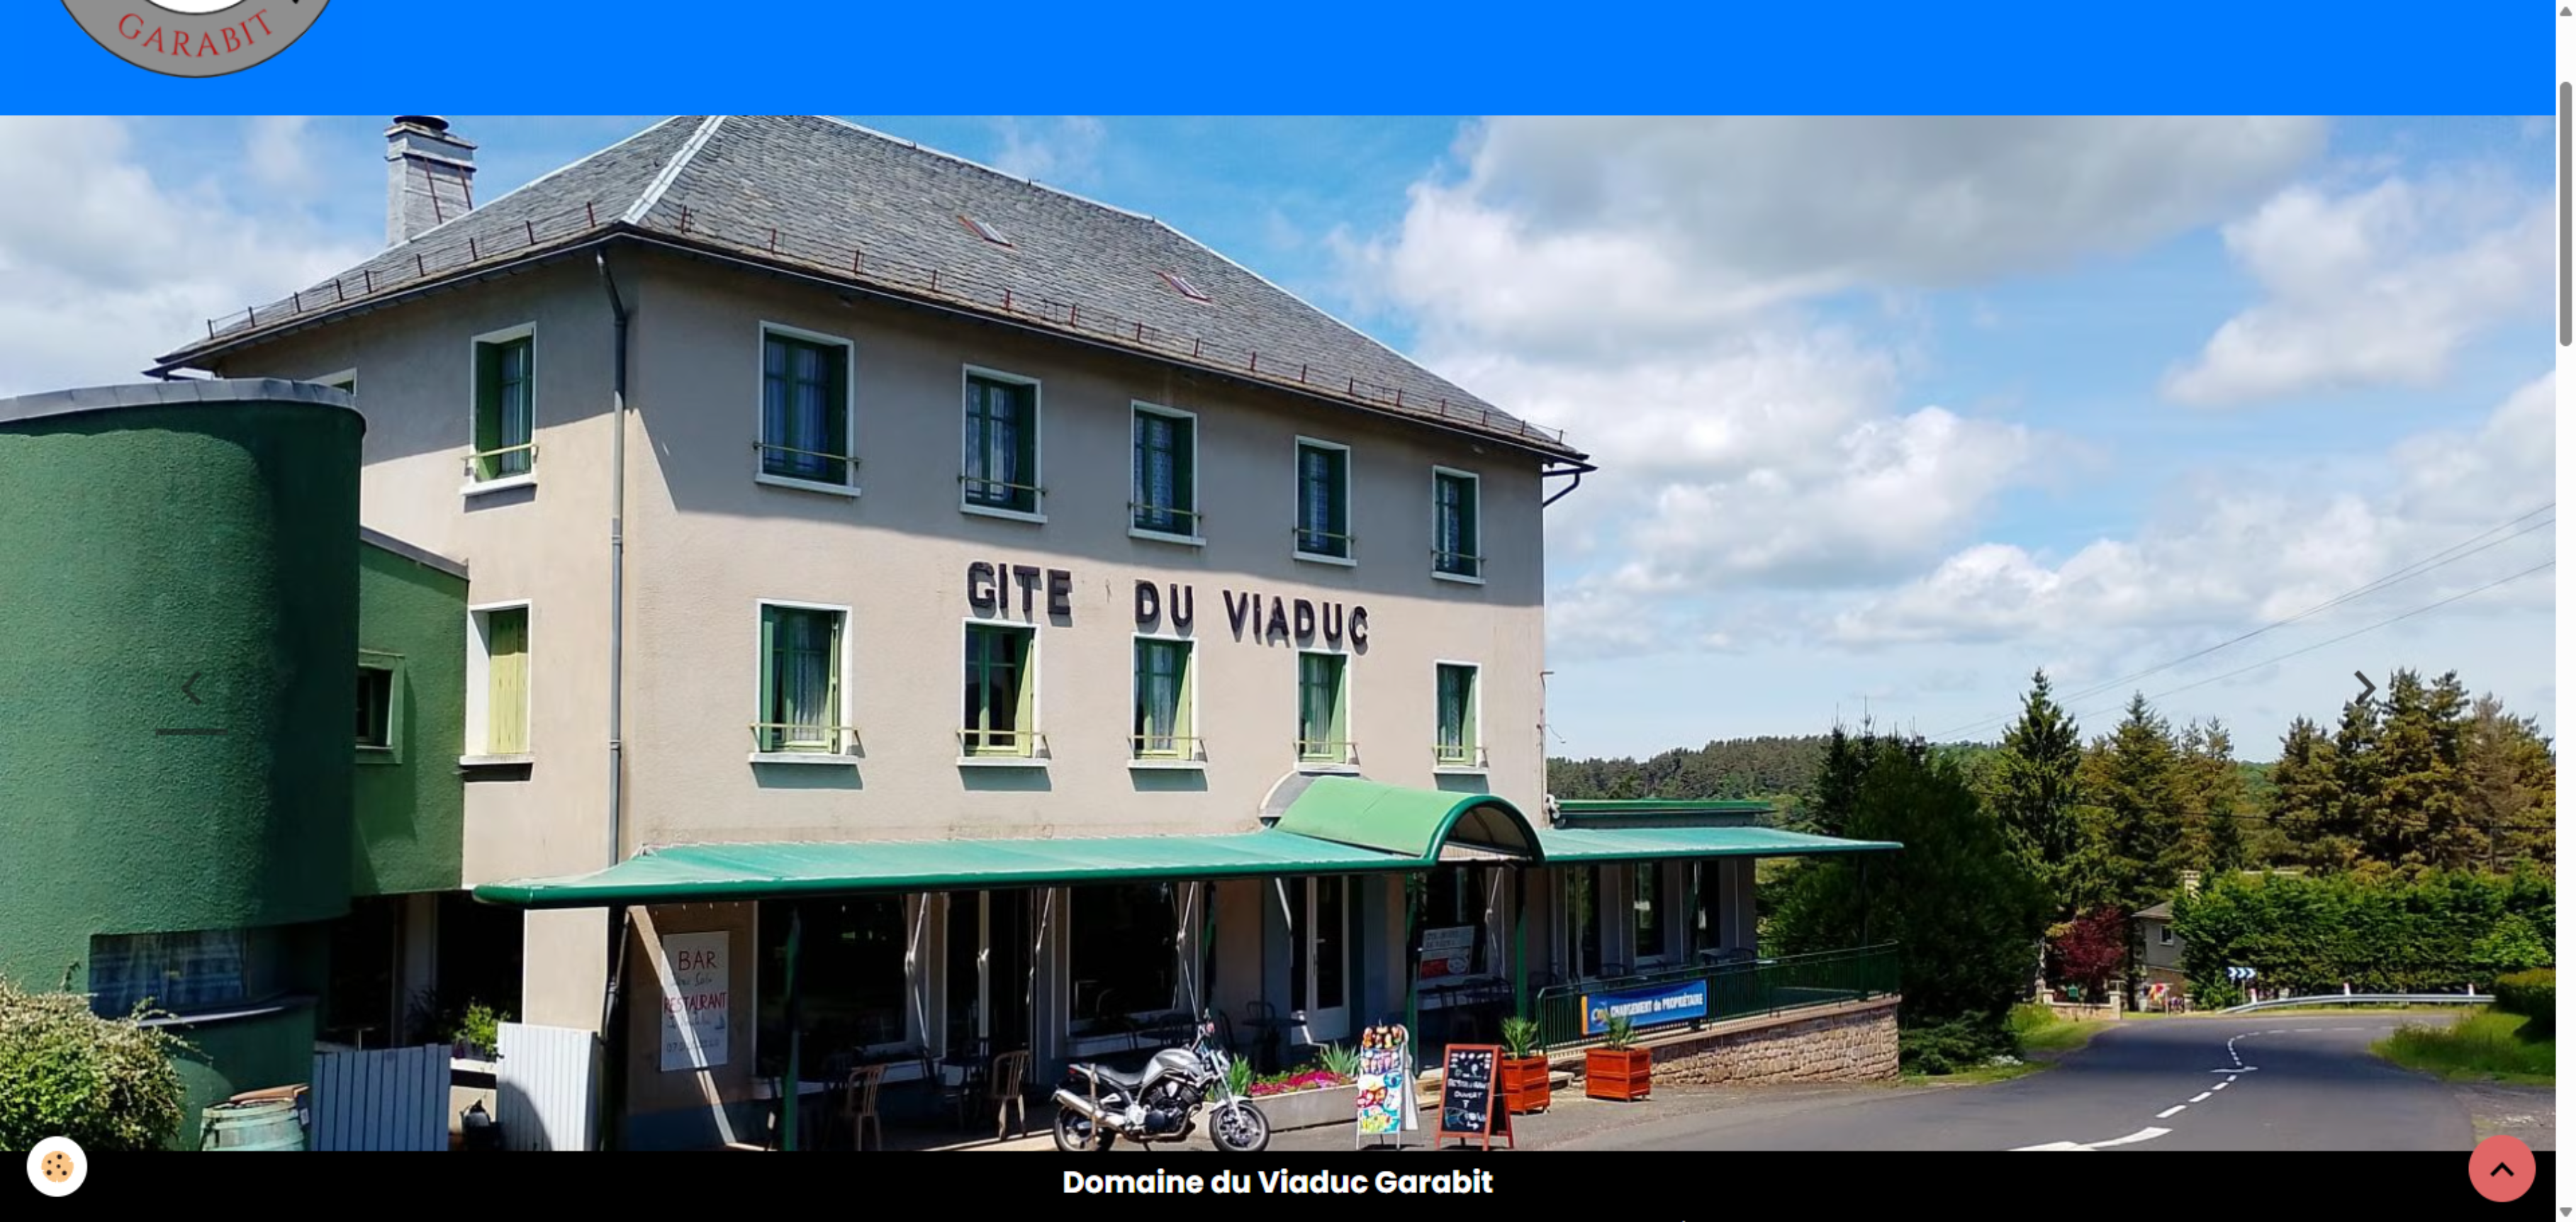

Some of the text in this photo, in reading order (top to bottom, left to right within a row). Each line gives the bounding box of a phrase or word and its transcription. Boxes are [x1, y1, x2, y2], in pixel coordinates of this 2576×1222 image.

[967, 561, 1369, 646] GITE DU VIADUC
[678, 950, 717, 971] BAR
[663, 992, 727, 1014] RESTAURANT
